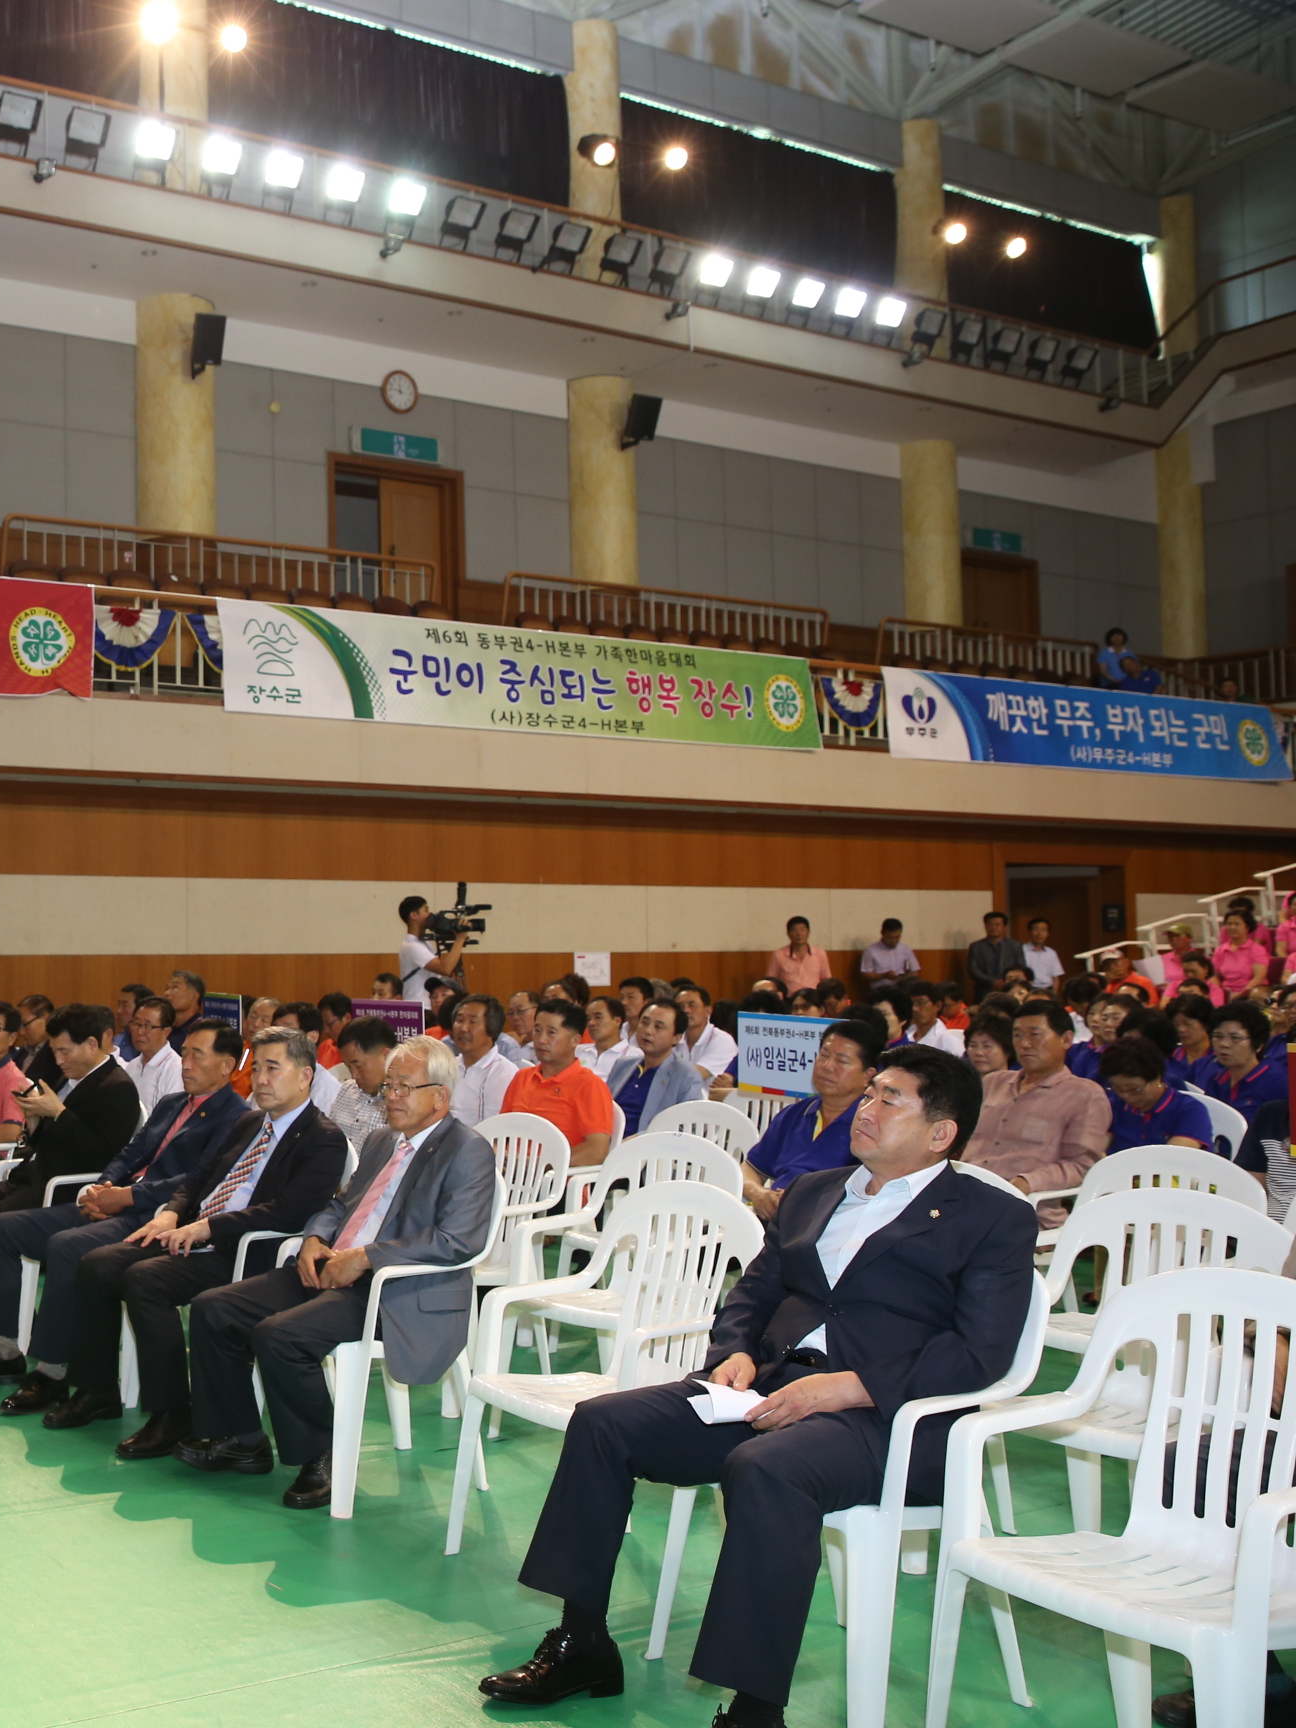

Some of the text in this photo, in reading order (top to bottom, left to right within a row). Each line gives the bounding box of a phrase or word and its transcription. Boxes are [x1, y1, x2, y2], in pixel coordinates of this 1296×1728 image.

[425, 627, 697, 669] 제6회 동부권4-H본부 가족한마음대회
[247, 685, 302, 704] 장수군
[389, 648, 484, 697] 군민이
[499, 658, 617, 711] 중심되는
[625, 669, 682, 717] 행복
[689, 677, 753, 719] 장수!
[490, 708, 645, 734] (사)장수군4-H본부
[986, 692, 1050, 736] 깨끗한
[1054, 699, 1101, 742] 무주,
[1106, 704, 1145, 743] 부자
[1148, 707, 1189, 747] 되는
[1191, 713, 1231, 751] 군민
[1070, 744, 1174, 768] (사)무주군4-H본부
[745, 1025, 760, 1037] 제6회
[746, 1045, 817, 1073] (사)임실군4-
